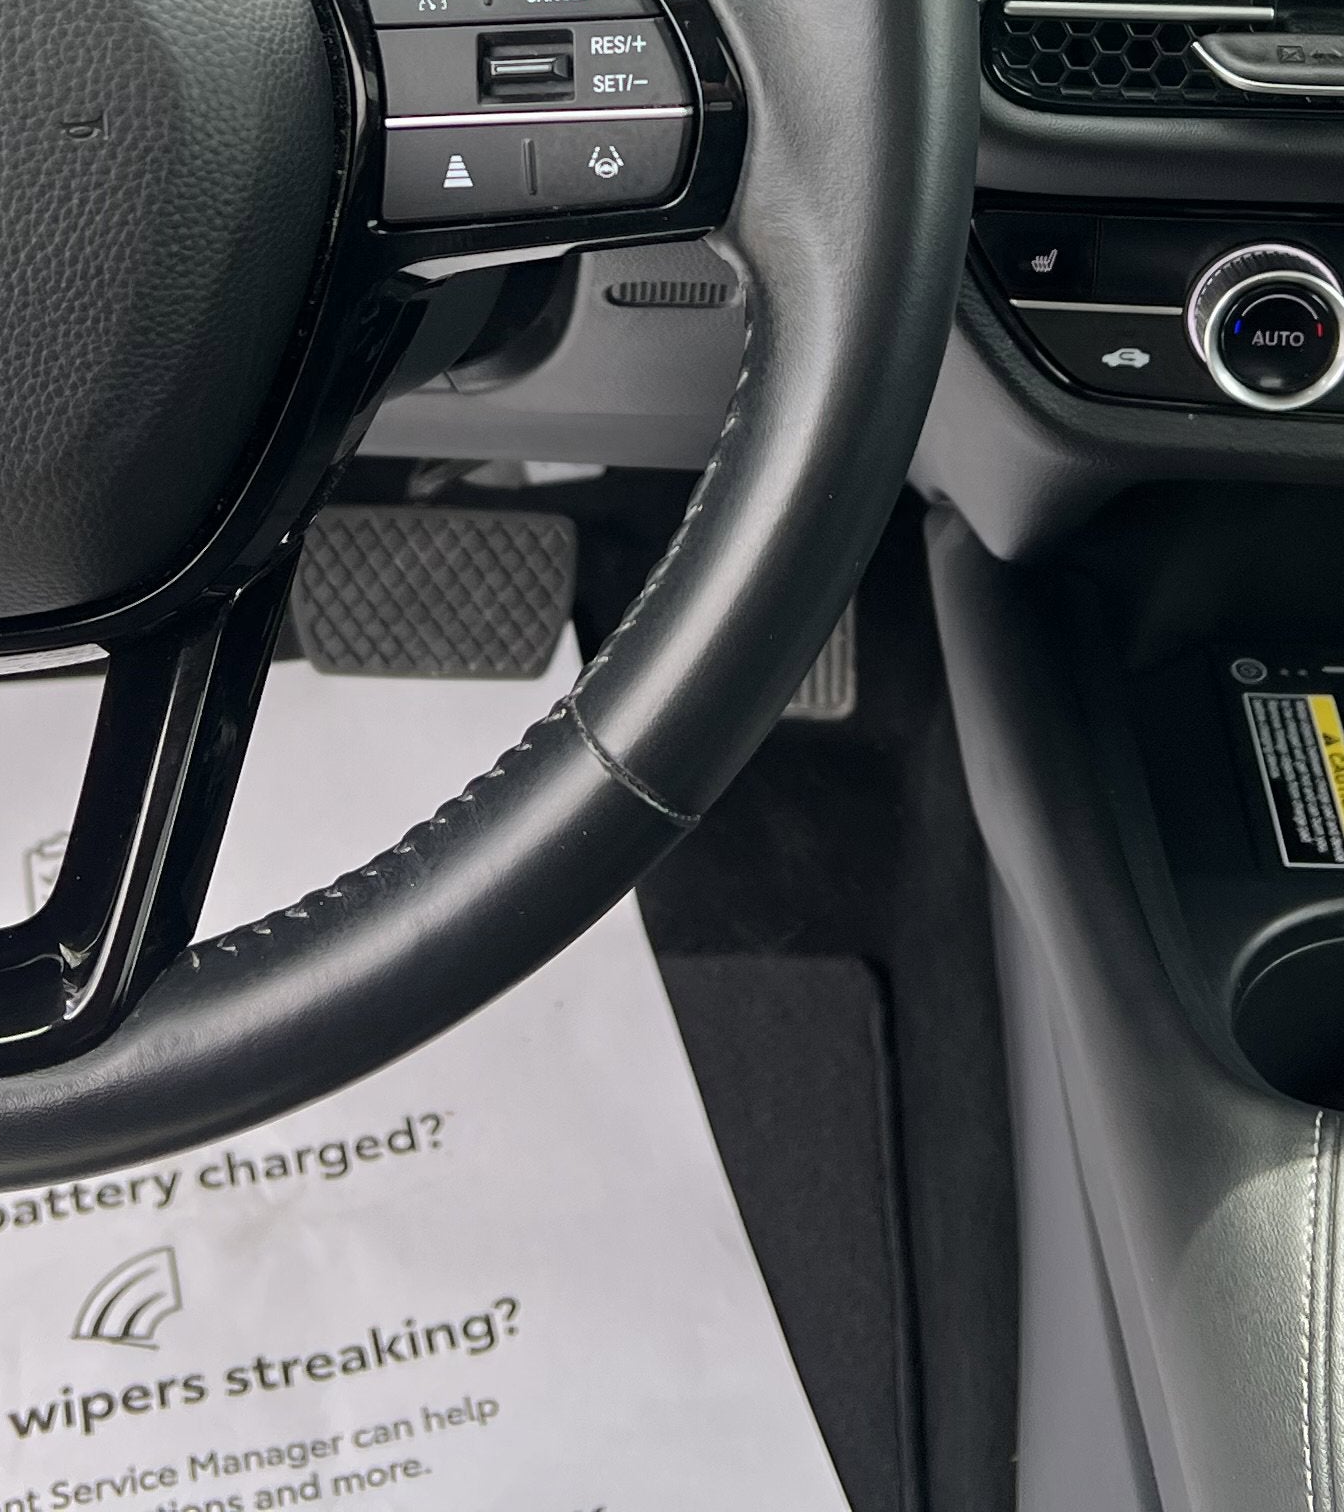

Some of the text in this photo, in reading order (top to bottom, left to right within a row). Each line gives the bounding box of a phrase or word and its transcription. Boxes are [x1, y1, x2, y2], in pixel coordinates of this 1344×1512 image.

[591, 35, 646, 55] RES/+
[1251, 330, 1304, 348] AUTO
[199, 1113, 444, 1190] charged?
[9, 1374, 208, 1435] wipers
[225, 1297, 519, 1398] streaking?
[52, 1464, 178, 1509] Service
[189, 1436, 342, 1481] Manager
[352, 1419, 414, 1449] can
[422, 1396, 500, 1432] help
[258, 1473, 322, 1510] and
[331, 1457, 433, 1496] more.
